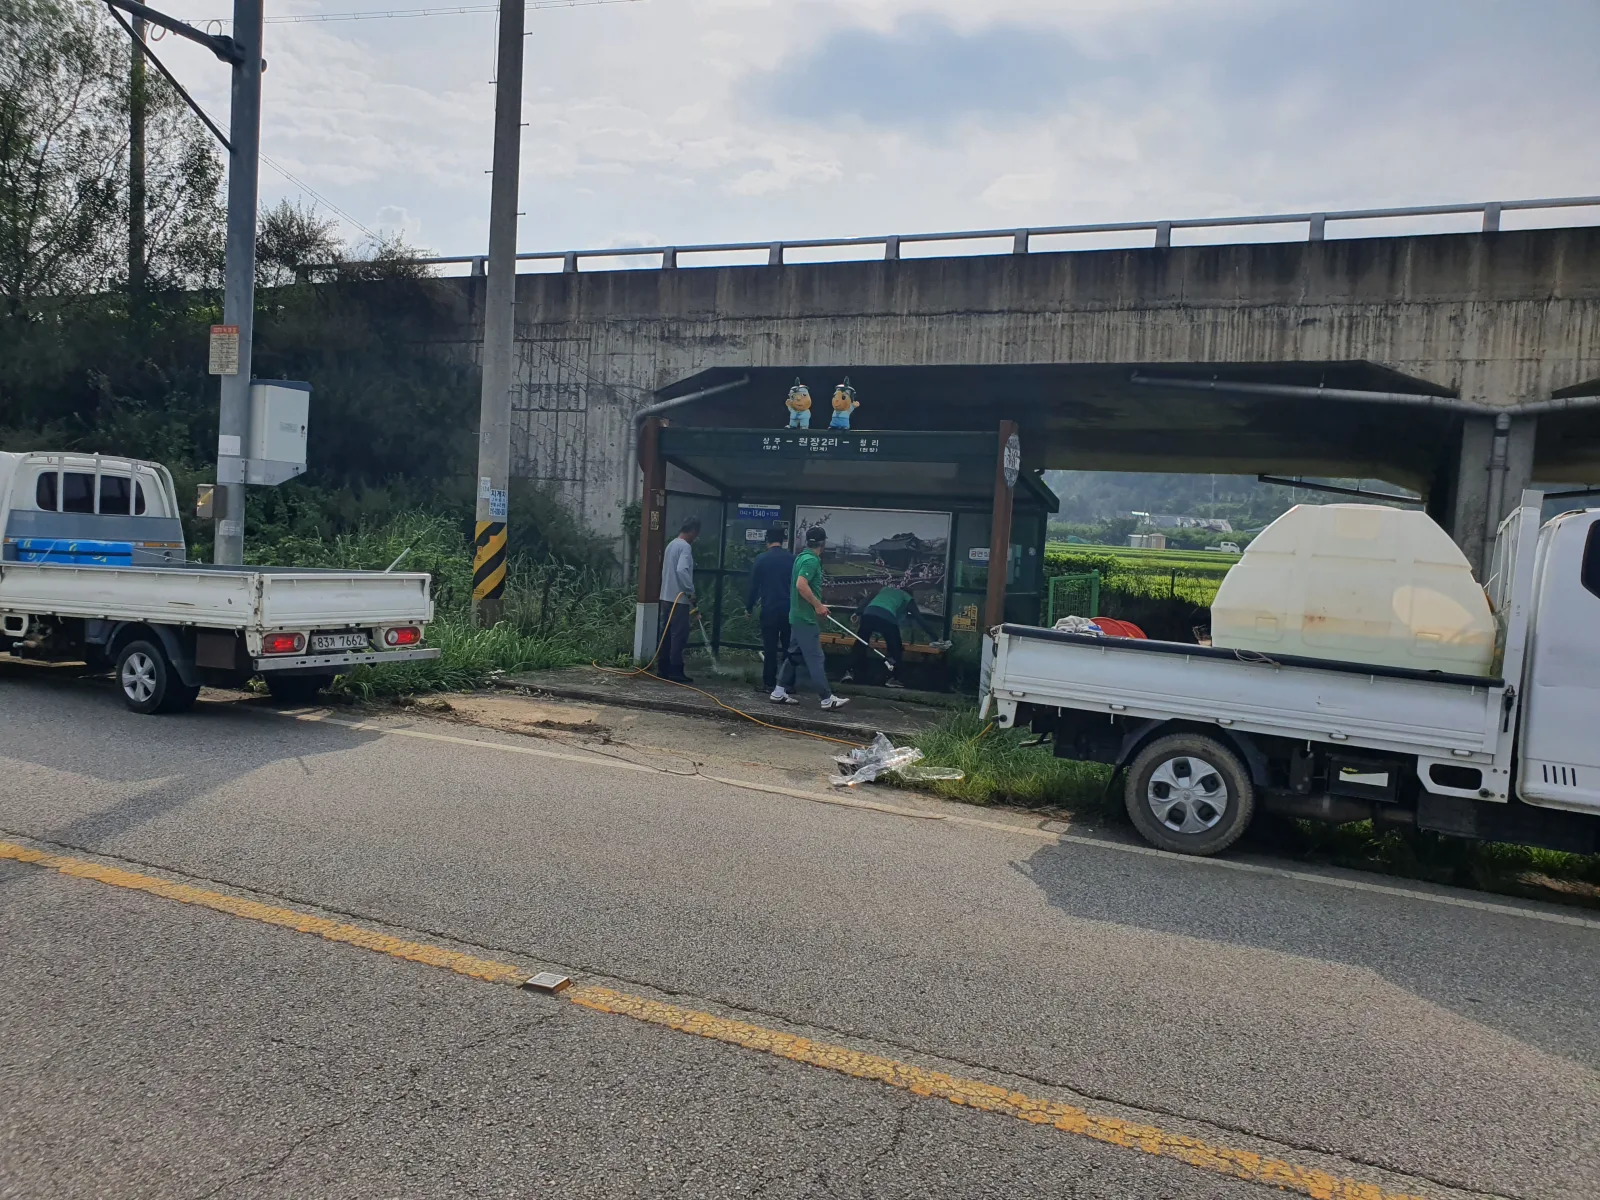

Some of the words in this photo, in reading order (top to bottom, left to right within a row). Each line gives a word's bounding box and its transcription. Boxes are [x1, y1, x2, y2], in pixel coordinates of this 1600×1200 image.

[798, 437, 838, 447] 원장2리
[752, 509, 766, 517] 1340
[339, 634, 364, 647] 7662
